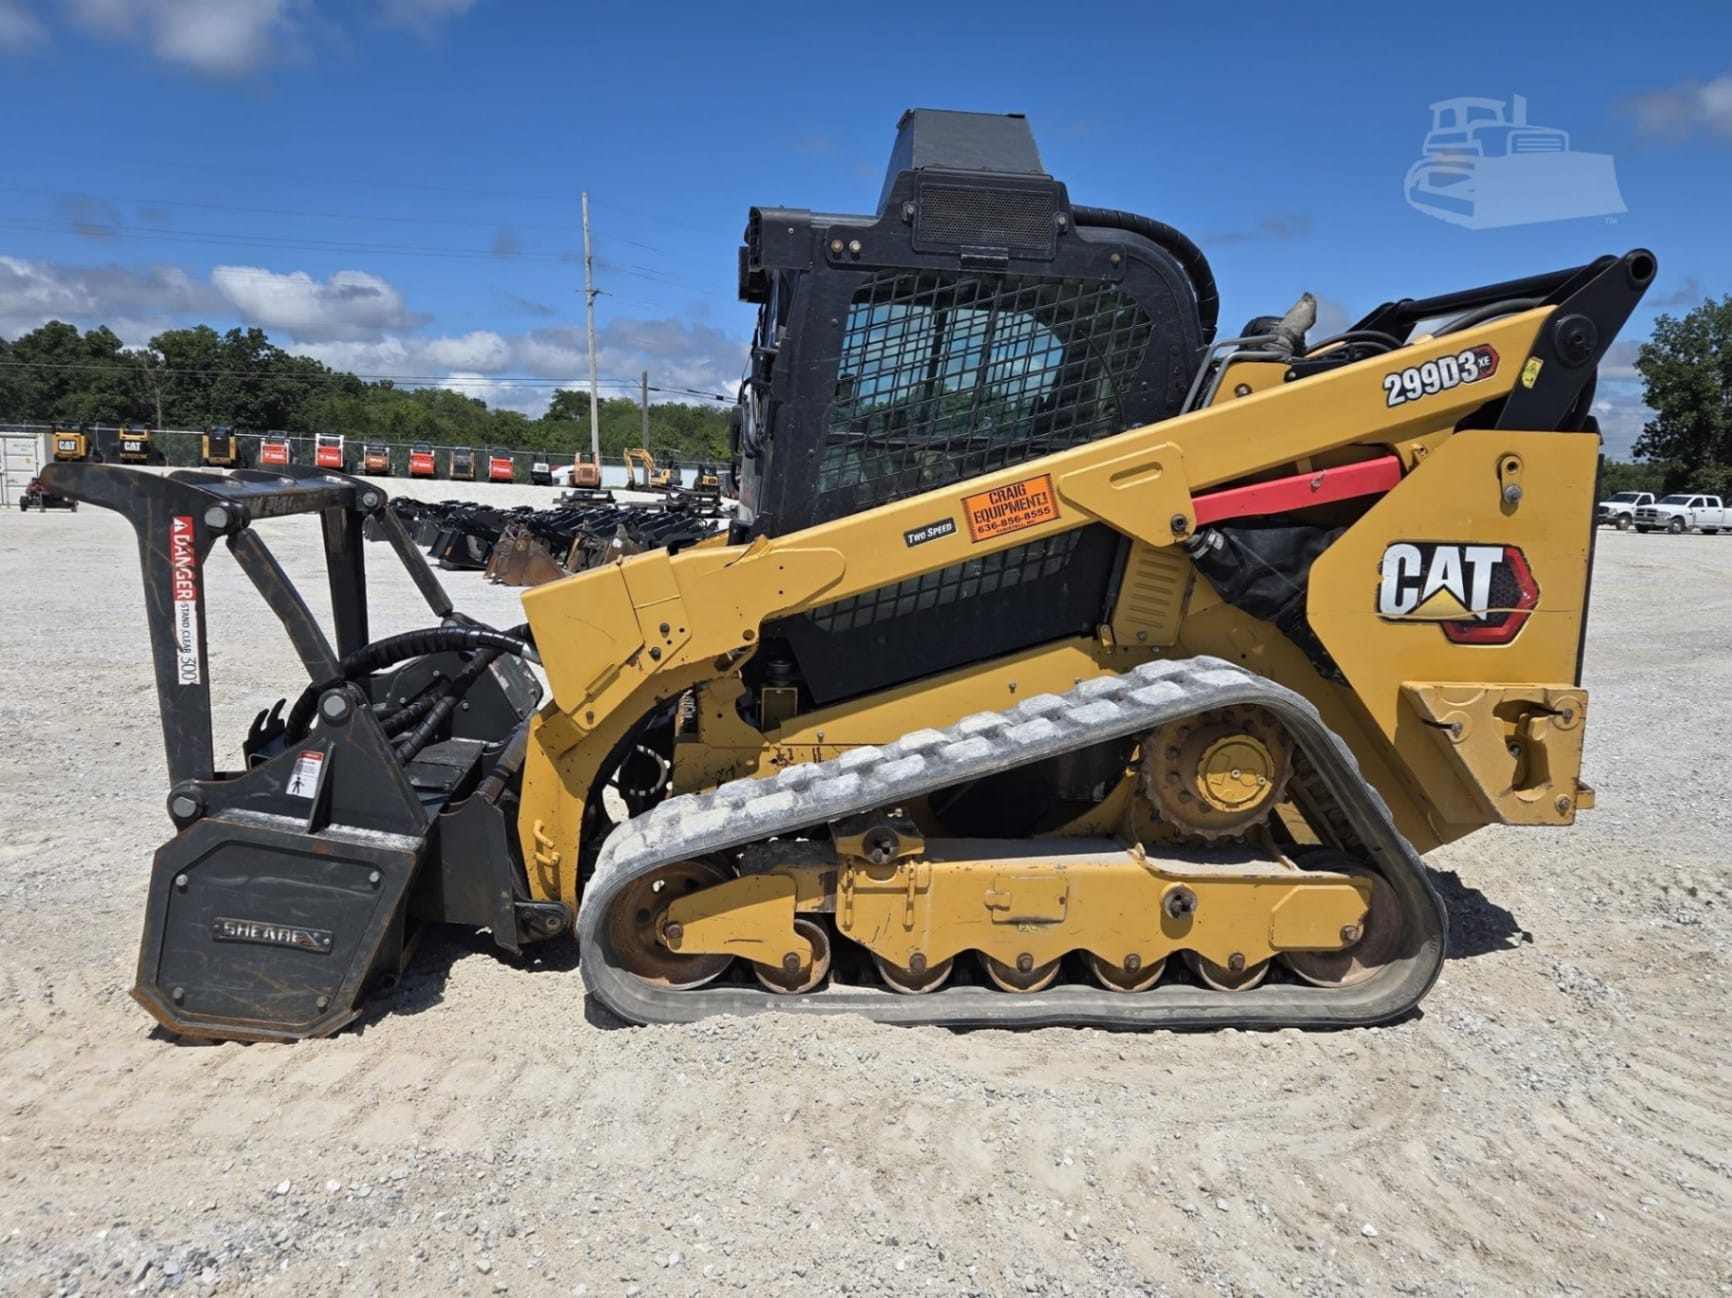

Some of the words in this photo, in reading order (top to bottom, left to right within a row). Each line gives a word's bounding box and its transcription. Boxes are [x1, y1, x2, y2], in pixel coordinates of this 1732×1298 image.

[1384, 350, 1478, 406] 299D3
[1478, 356, 1491, 368] XE
[58, 441, 76, 451] CAT
[123, 441, 141, 451] CAT
[989, 483, 1026, 504] CRAIG
[977, 506, 1051, 534] 636-856-8555
[173, 535, 193, 600] DANGER
[1379, 543, 1504, 621] CAT
[181, 603, 190, 628] STAND
[182, 629, 192, 654] CLEAR
